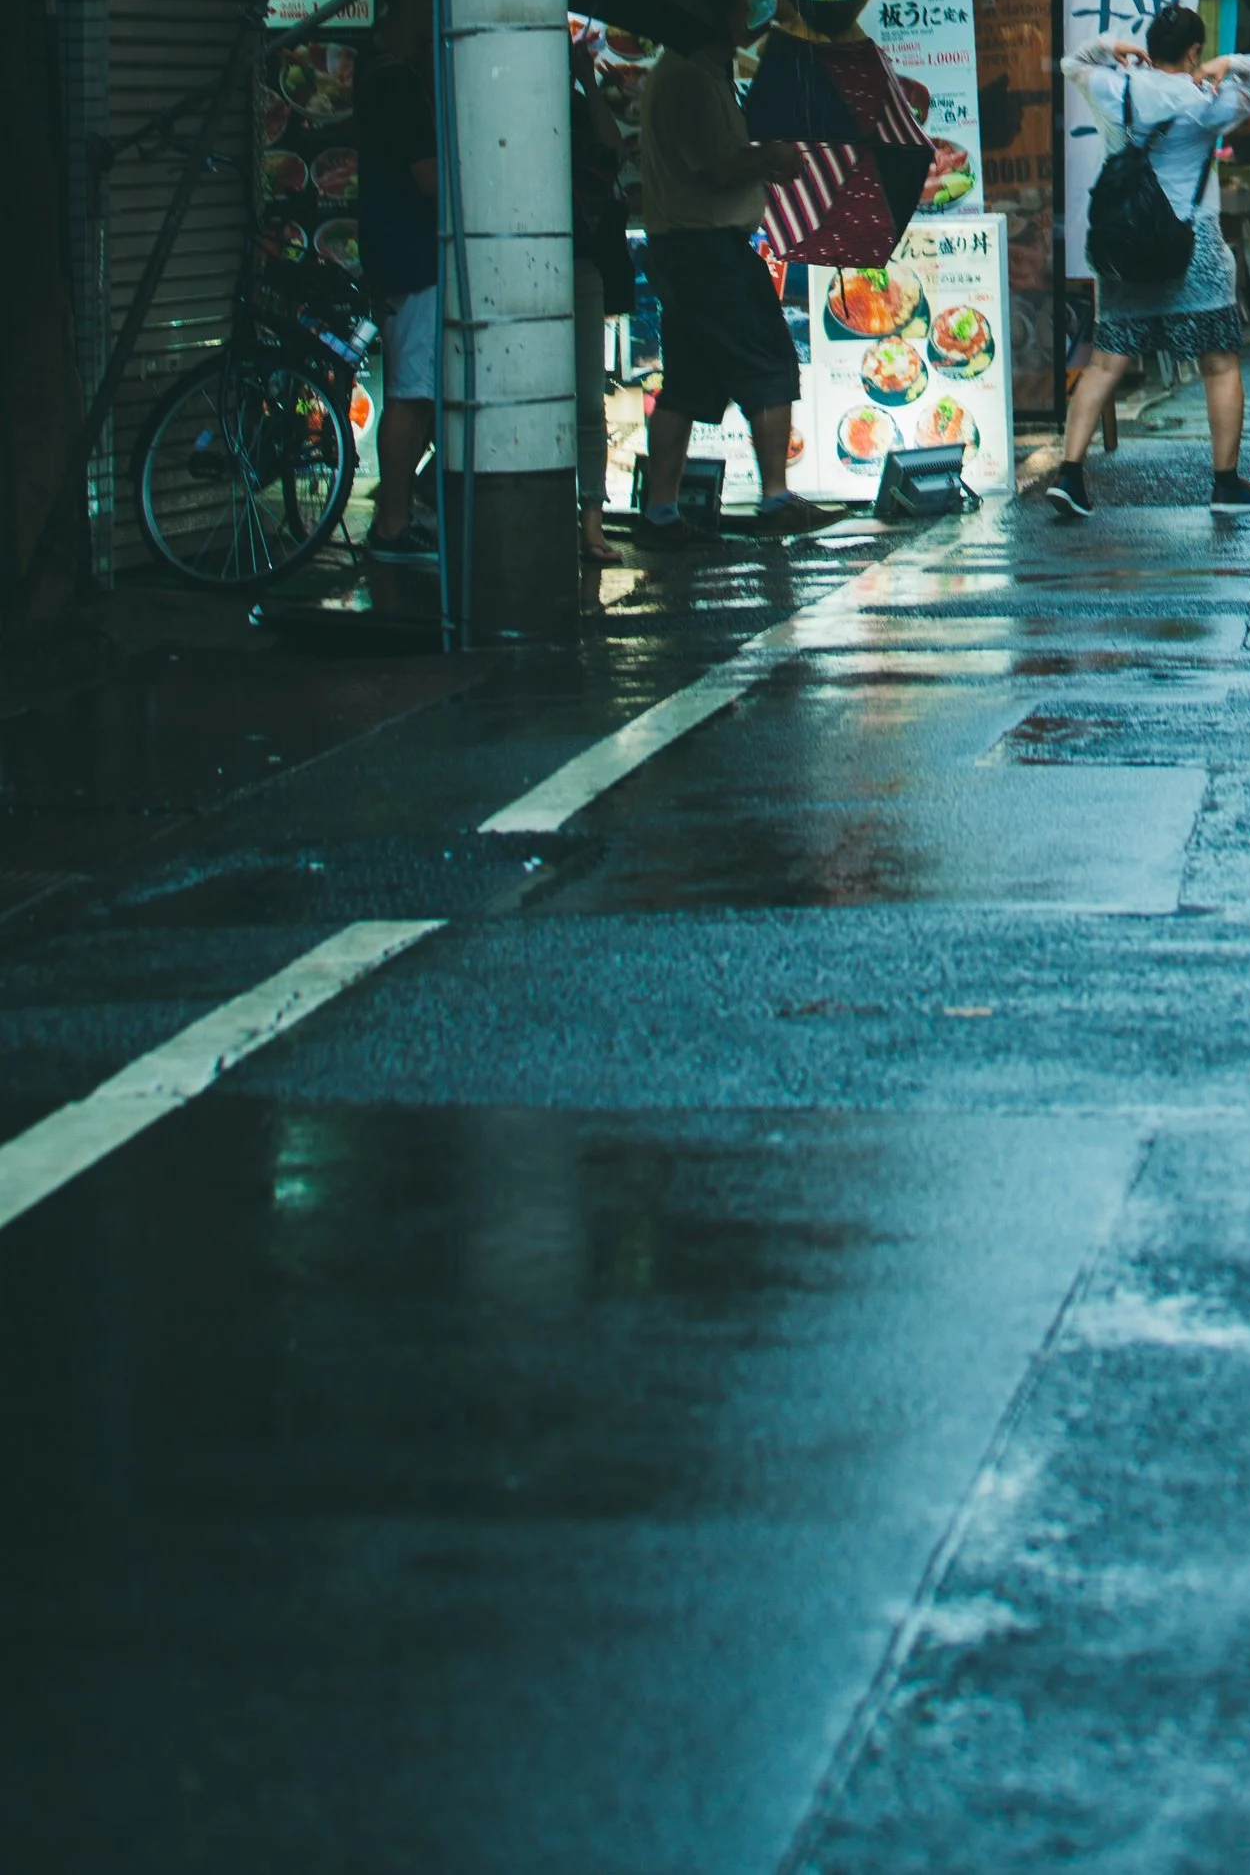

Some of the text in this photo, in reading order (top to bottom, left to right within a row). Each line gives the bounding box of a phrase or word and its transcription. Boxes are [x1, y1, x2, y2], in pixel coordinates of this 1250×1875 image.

[900, 230, 992, 260] んこ盛り丼
